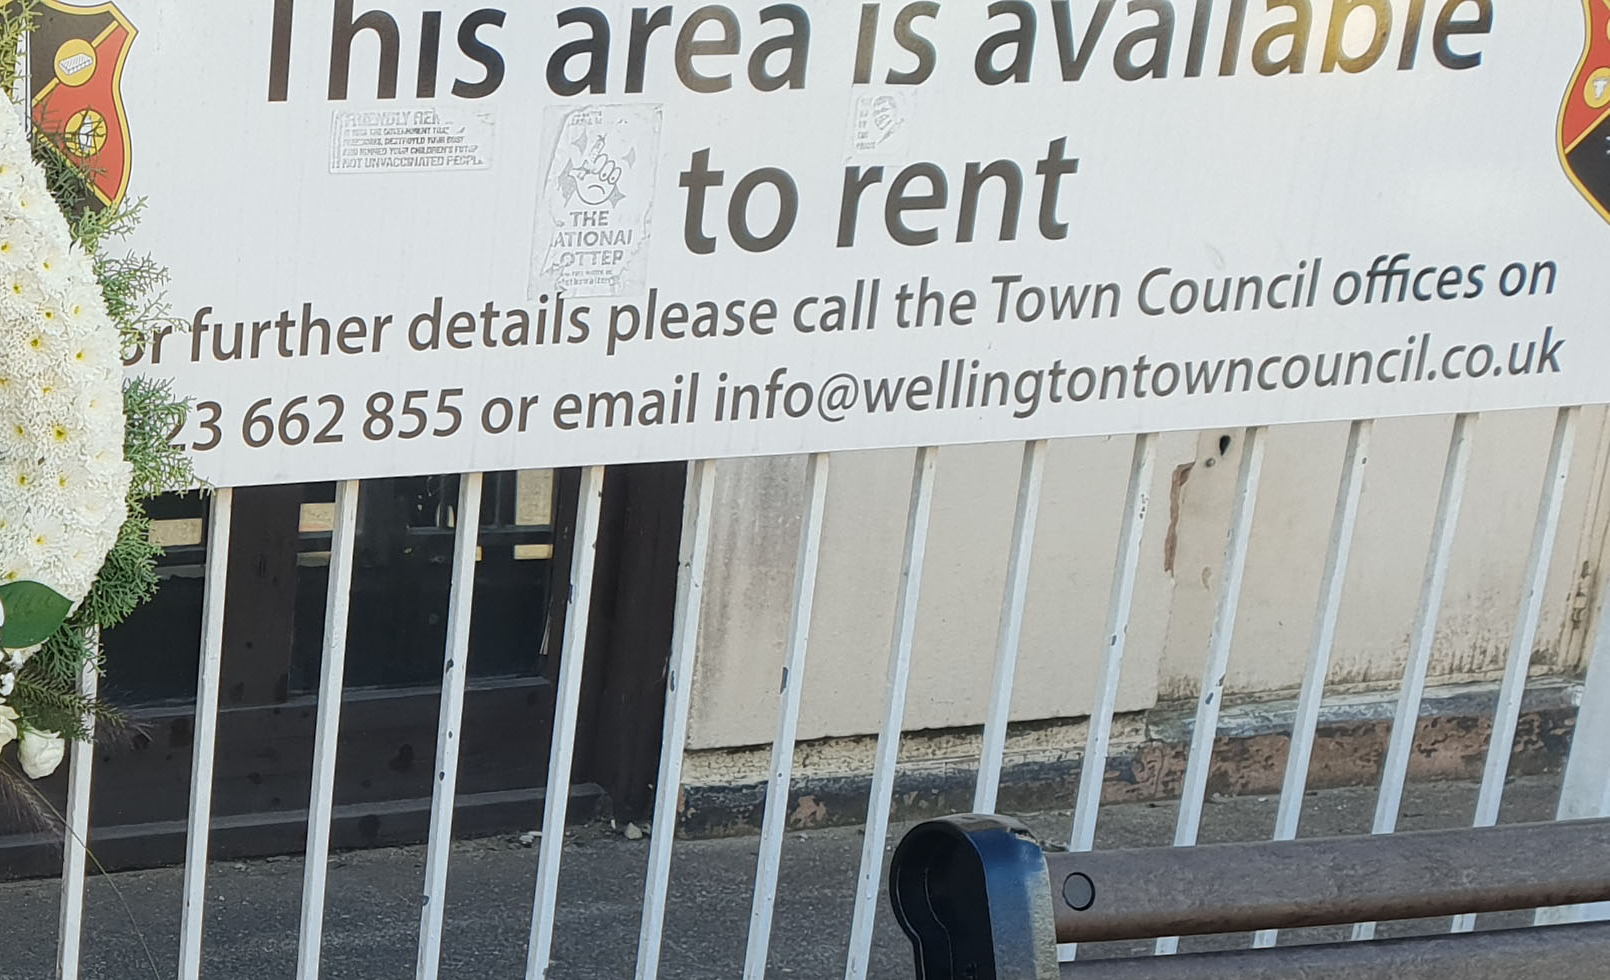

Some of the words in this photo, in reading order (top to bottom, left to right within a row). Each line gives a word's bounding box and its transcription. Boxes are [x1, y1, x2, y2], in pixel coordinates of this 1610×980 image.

[268, 0, 506, 102] This
[546, 3, 810, 96] area
[853, 0, 940, 87] is
[975, 0, 1493, 86] available
[679, 148, 798, 254] to
[837, 136, 1079, 249] rent
[191, 306, 393, 363] further
[408, 290, 590, 352] details
[606, 287, 777, 356] please
[794, 278, 881, 334] call
[895, 276, 977, 329] the
[992, 274, 1120, 325] Town
[1137, 257, 1322, 316] Council
[1333, 252, 1487, 307] offices
[1499, 261, 1557, 298] on
[242, 393, 345, 449] 662
[362, 387, 464, 442] 855
[481, 394, 539, 435] or
[553, 371, 699, 431] email
[715, 325, 1566, 423] info@wellingtontowncouncil.co.uk
